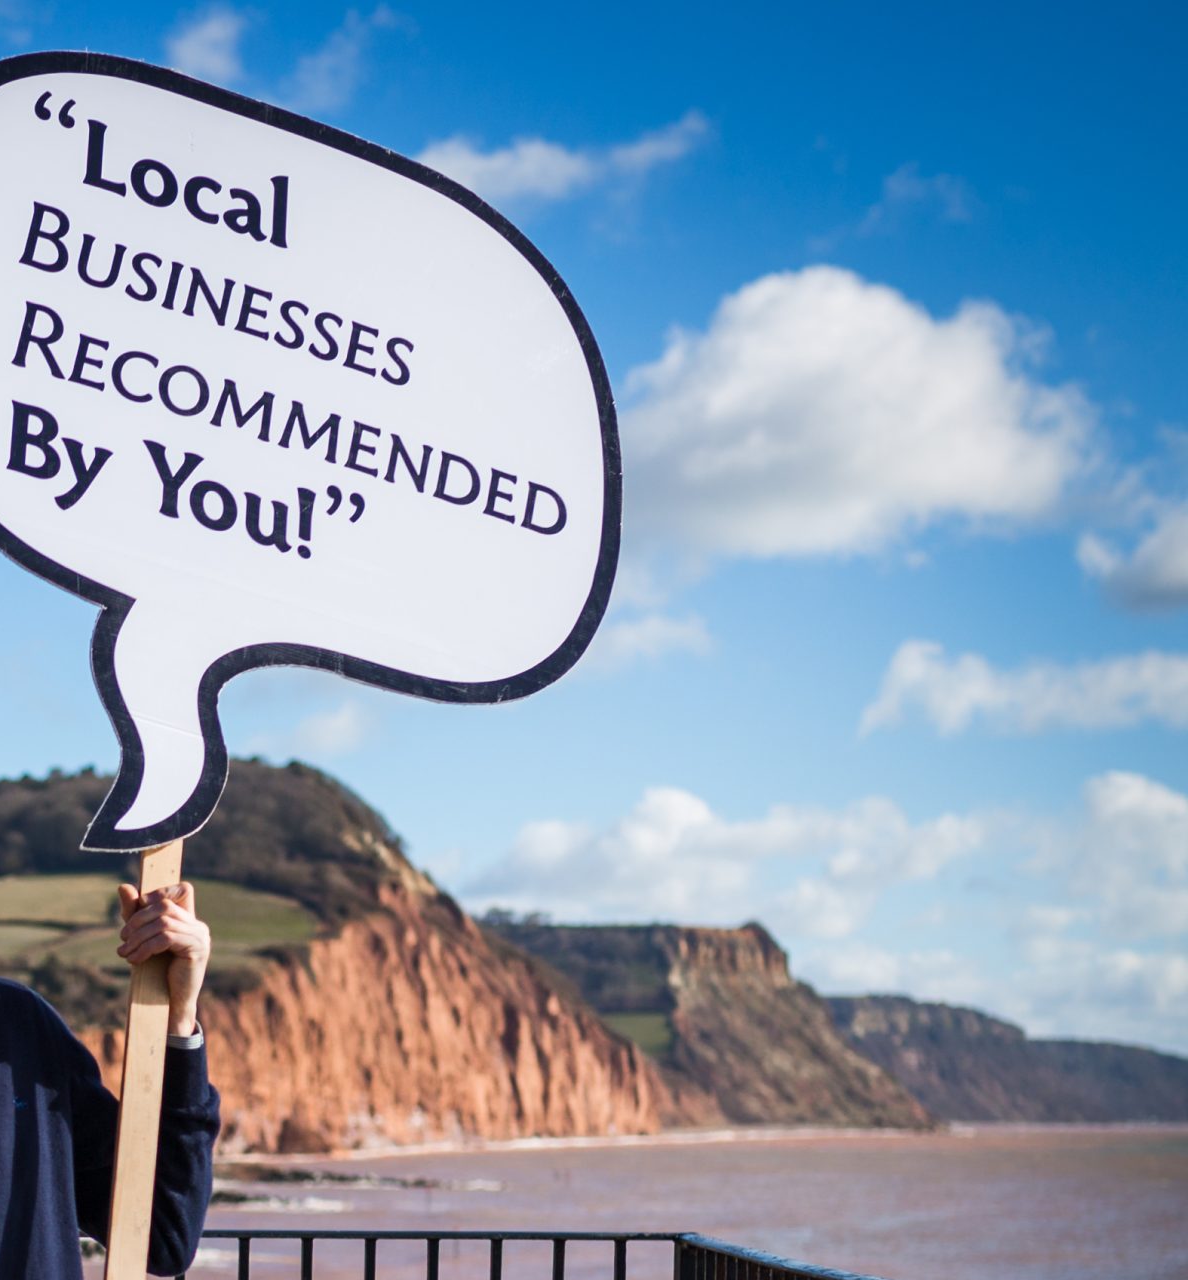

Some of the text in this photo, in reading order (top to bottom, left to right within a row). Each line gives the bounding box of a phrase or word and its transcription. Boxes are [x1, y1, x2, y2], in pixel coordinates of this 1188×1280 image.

[34, 90, 289, 249] “Local
[6, 399, 366, 559] By You!”
